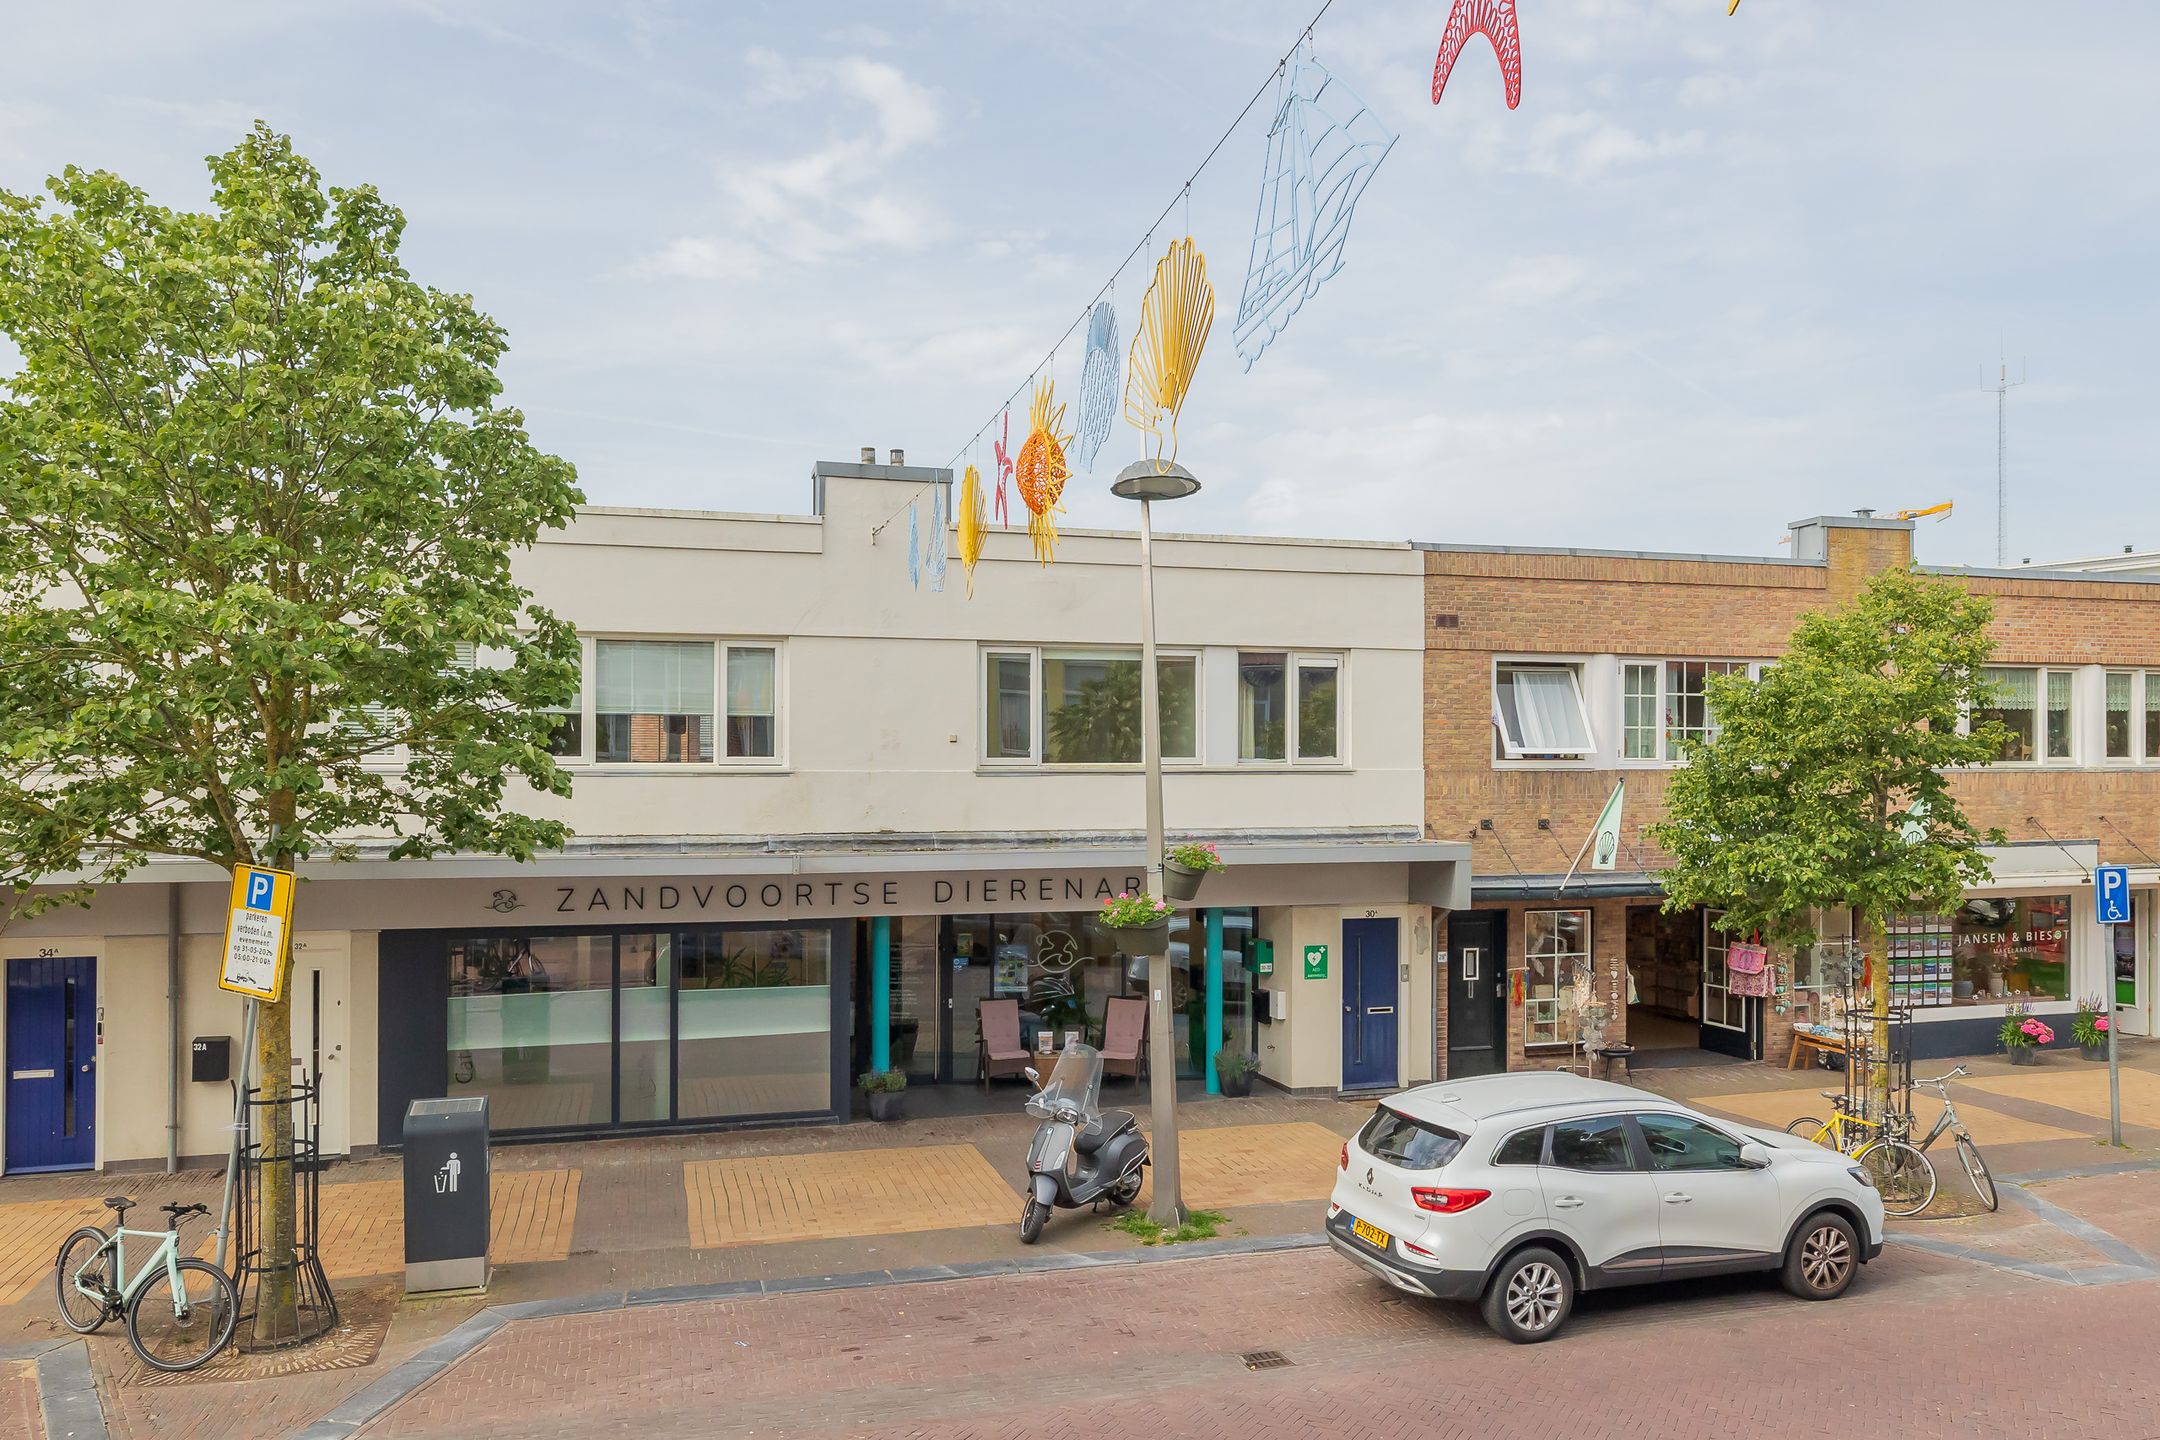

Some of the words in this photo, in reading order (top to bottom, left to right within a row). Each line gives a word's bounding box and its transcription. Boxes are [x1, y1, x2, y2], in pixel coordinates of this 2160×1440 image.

[251, 876, 269, 905] P
[2104, 871, 2121, 899] P
[556, 881, 898, 912] ZANDVOORTSE
[246, 912, 267, 924] parkeren
[237, 924, 260, 936] verboden
[239, 936, 270, 947] evenement
[1958, 932, 2005, 947] JANSEN
[2012, 932, 2020, 942] &
[233, 945, 241, 953] op
[1993, 946, 2037, 954] MAKELAARDIJ
[193, 1043, 207, 1051] 32A
[1355, 1220, 1386, 1245] P-702-TX
